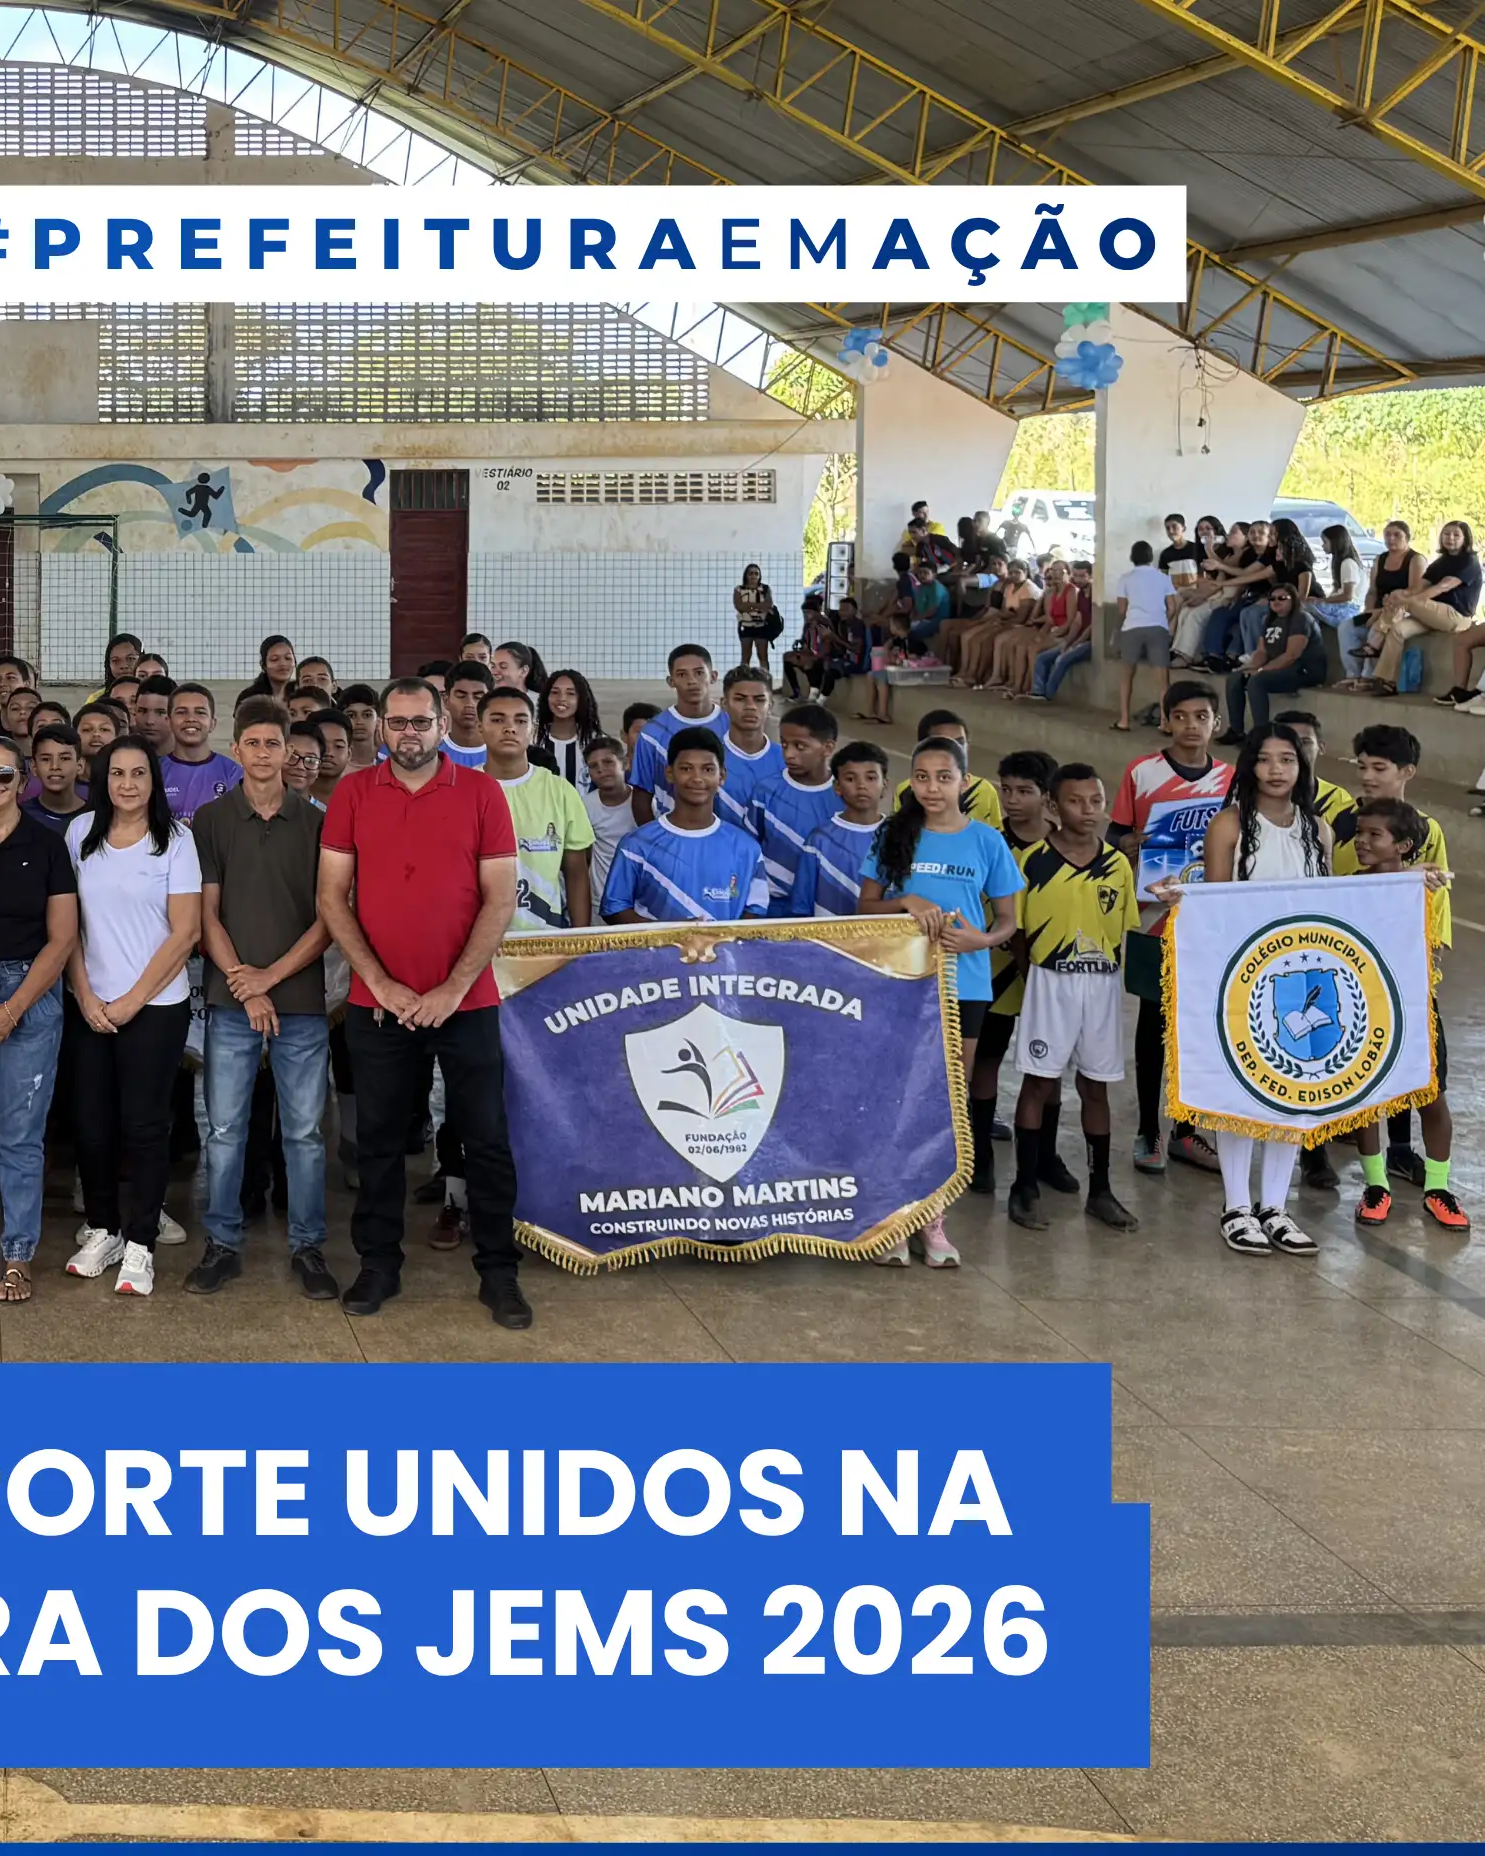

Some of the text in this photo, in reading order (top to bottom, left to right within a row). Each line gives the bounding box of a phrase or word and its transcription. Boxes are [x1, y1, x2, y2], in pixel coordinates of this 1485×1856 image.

[496, 480, 510, 491] 02
[1240, 932, 1367, 984] COLÉGIO MUNICIPAL
[543, 974, 863, 1035] UNIDADE INTEGRADA
[1236, 1026, 1385, 1102] DEP. FED. EDISON LOBÃO
[685, 1131, 747, 1143] FUNDAÇÃO
[579, 1176, 859, 1213] MARIANO MARTINS
[589, 1207, 854, 1235] CONSTRUINDO NOVAS HISTÓRIAS
